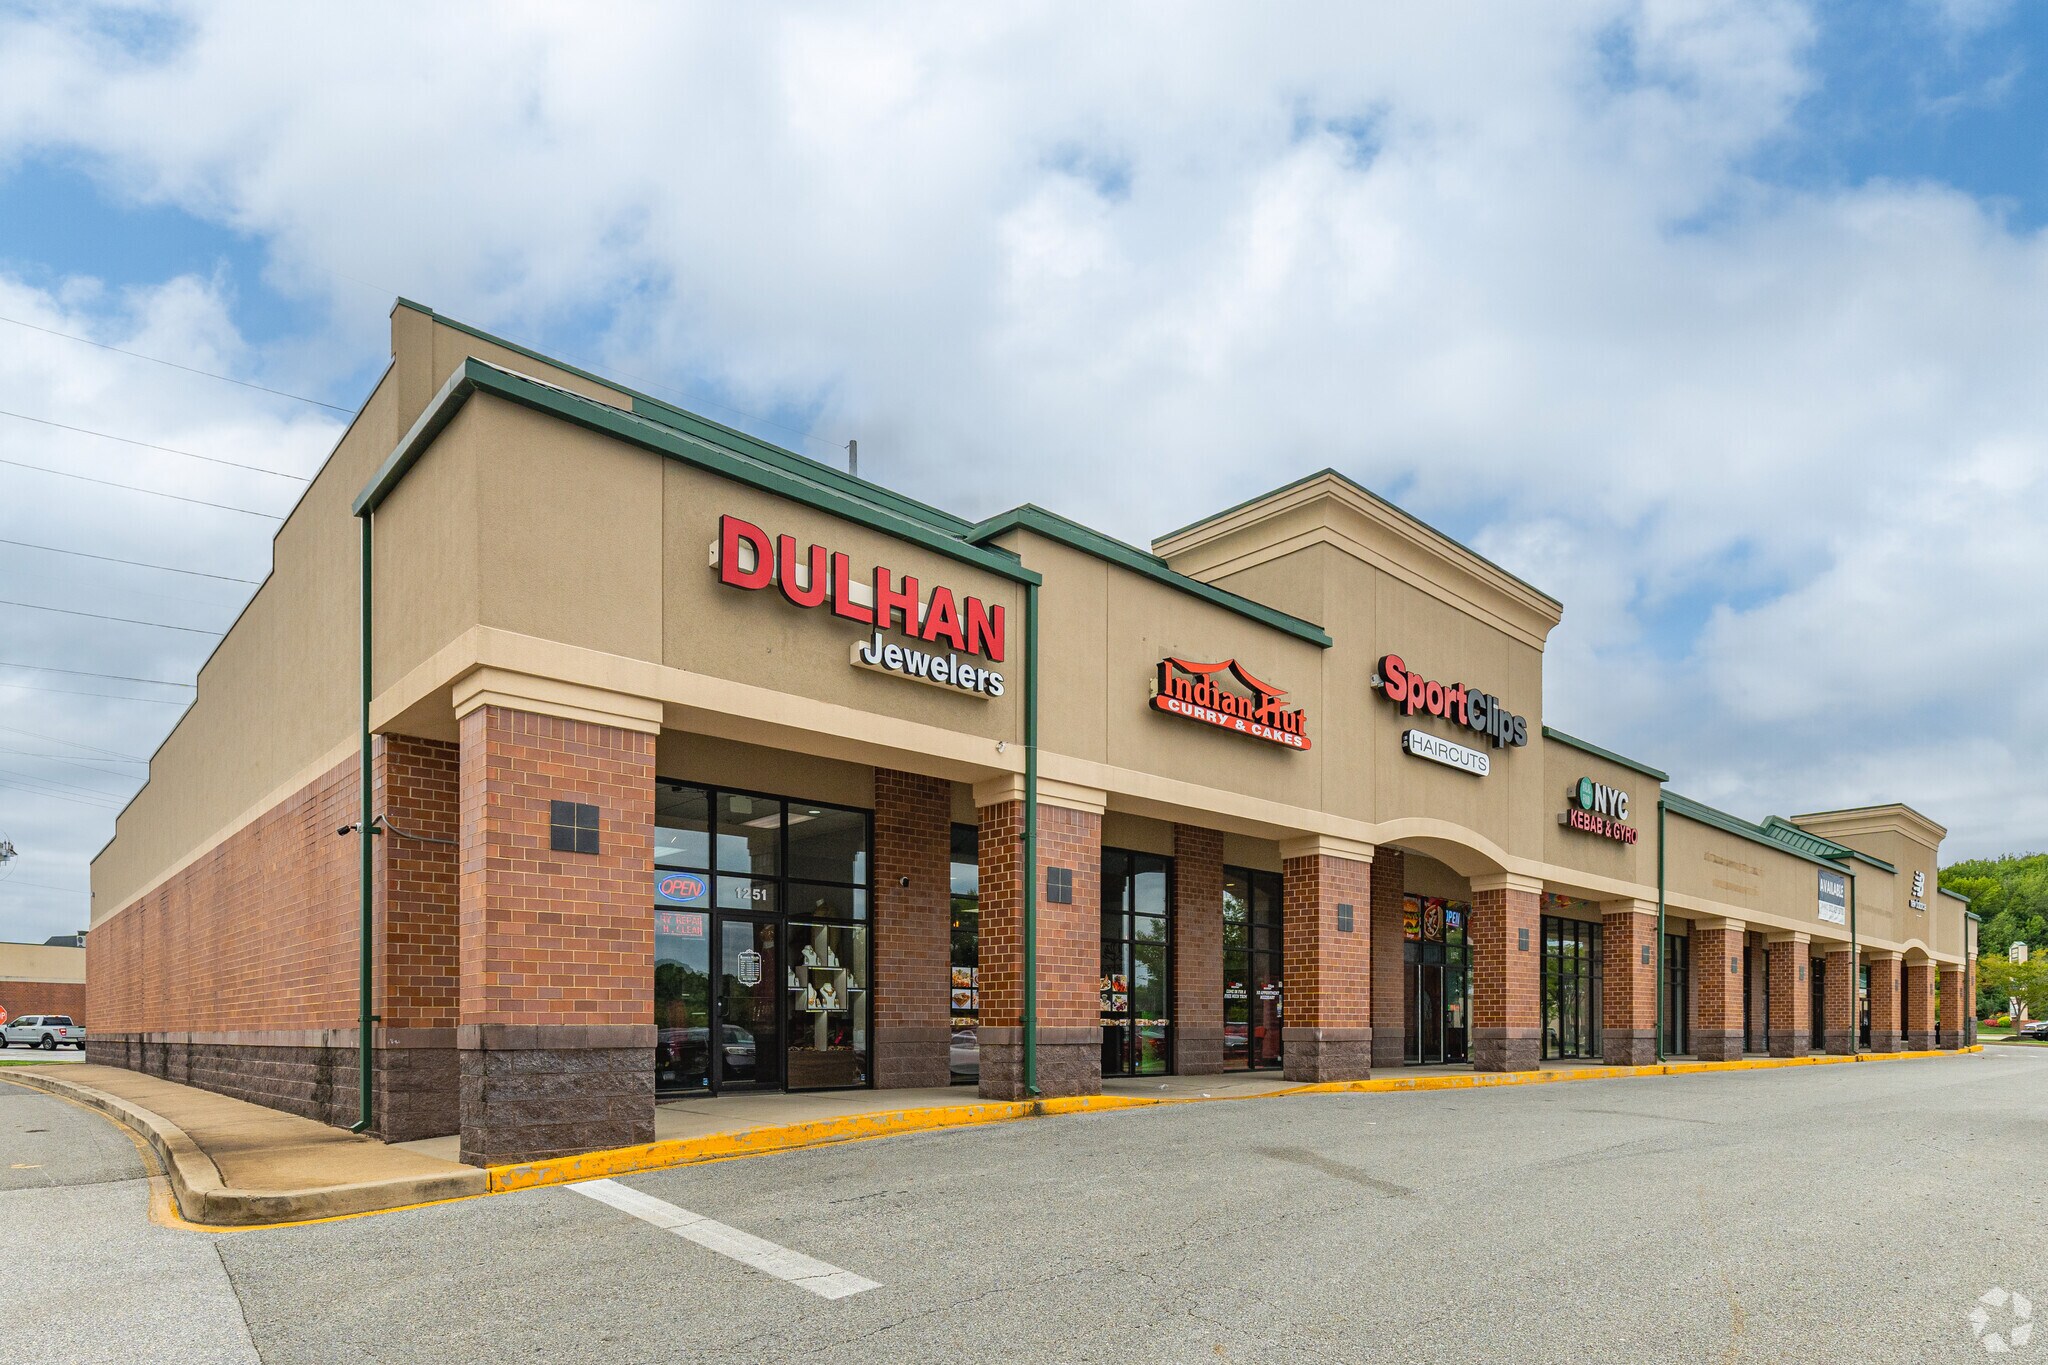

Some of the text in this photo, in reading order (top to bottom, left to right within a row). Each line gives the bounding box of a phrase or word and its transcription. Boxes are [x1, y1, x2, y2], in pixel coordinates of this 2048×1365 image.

[719, 514, 1005, 662] DULHAN
[861, 632, 1005, 697] Jewelers
[1159, 661, 1307, 736] Indian Hut
[1168, 699, 1303, 747] CURRY & CAKES
[1412, 734, 1487, 771] HAIRCUTS
[1593, 782, 1630, 820] NYC
[1570, 809, 1639, 845] KEBAB & GYRO
[661, 879, 702, 897] OPEN
[735, 887, 767, 901] 1251
[1820, 879, 1844, 898] AVAILABLE
